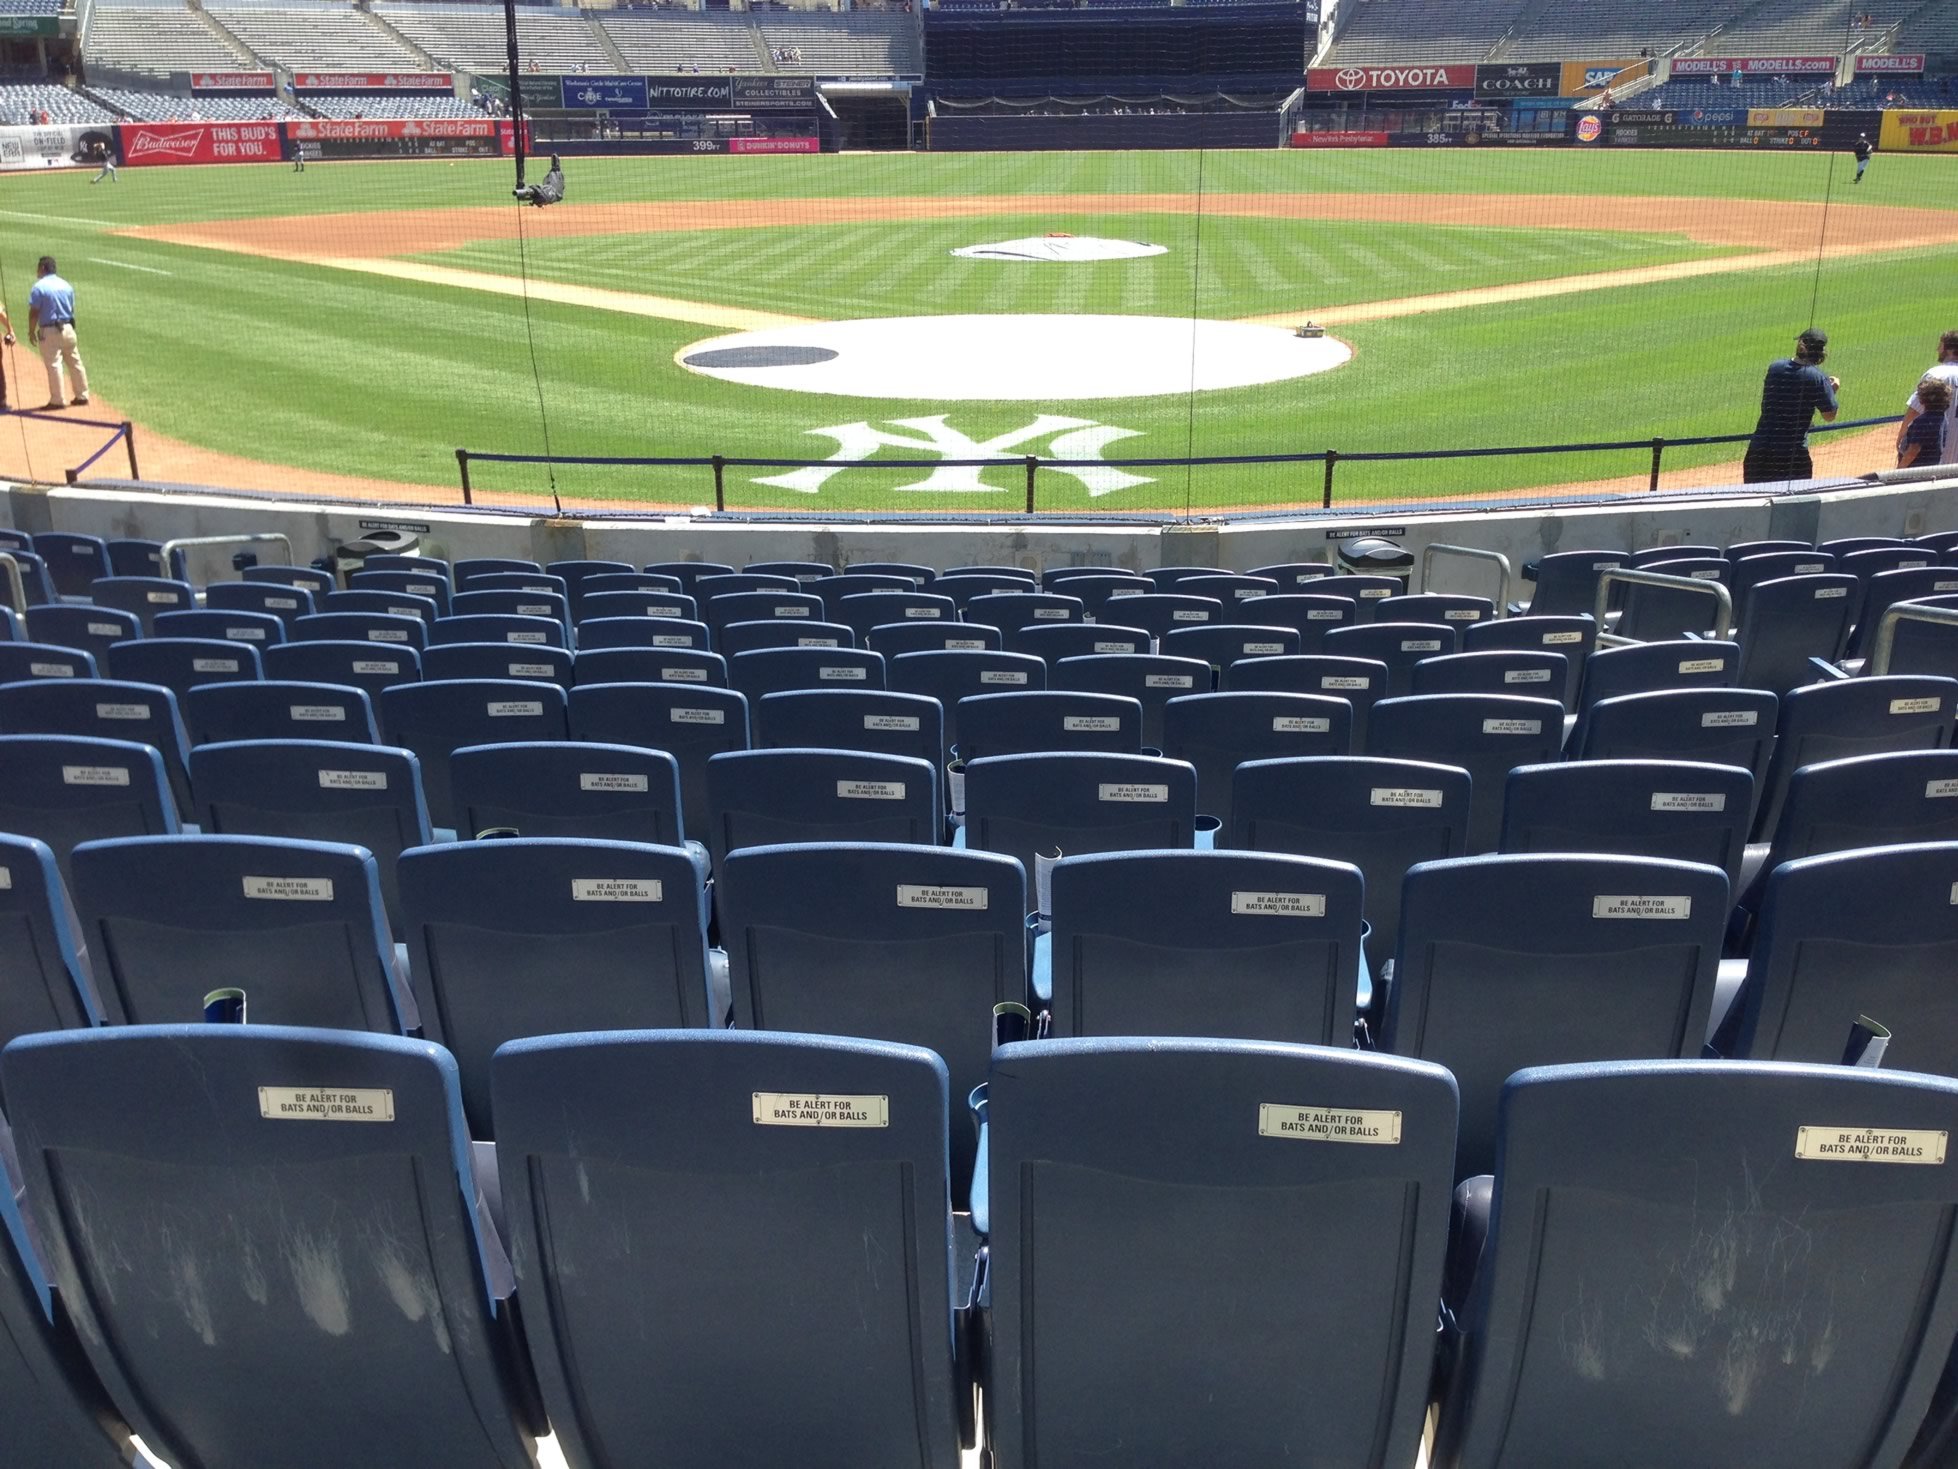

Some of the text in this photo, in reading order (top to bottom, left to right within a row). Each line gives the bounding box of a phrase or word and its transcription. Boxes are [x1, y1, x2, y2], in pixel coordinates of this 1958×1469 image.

[1676, 60, 1727, 71] MODELL'S
[1747, 59, 1830, 70] MODELLS.com
[1862, 58, 1918, 69] MODELL'S
[1369, 69, 1449, 86] TOYOTA
[1585, 71, 1615, 86] SAP
[1482, 78, 1551, 90] COACH
[650, 85, 729, 98] NITTOTIRE.COM
[745, 89, 801, 97] COLLECTIBLES
[1623, 114, 1661, 122] GATORADE
[1704, 111, 1734, 123] pepsi
[211, 126, 276, 140] THIS BUD'S
[135, 136, 197, 150] Budweiser
[213, 143, 236, 156] FOR
[1263, 904, 1290, 912] AND/OR
[295, 1093, 357, 1103] BE ALERT FOR
[280, 1103, 373, 1114] BATS AND/OR BALLS
[789, 1100, 851, 1110] BE ALERT FOR
[773, 1109, 867, 1121] BATS AND/OR BALLS
[1298, 1112, 1363, 1125] BE ALERT FOR
[1281, 1122, 1379, 1137] BATS AND/OR BALLS
[1839, 1134, 1908, 1145] BE ALERT FOR
[1820, 1144, 1925, 1156] BATS AND/OR BALLS
